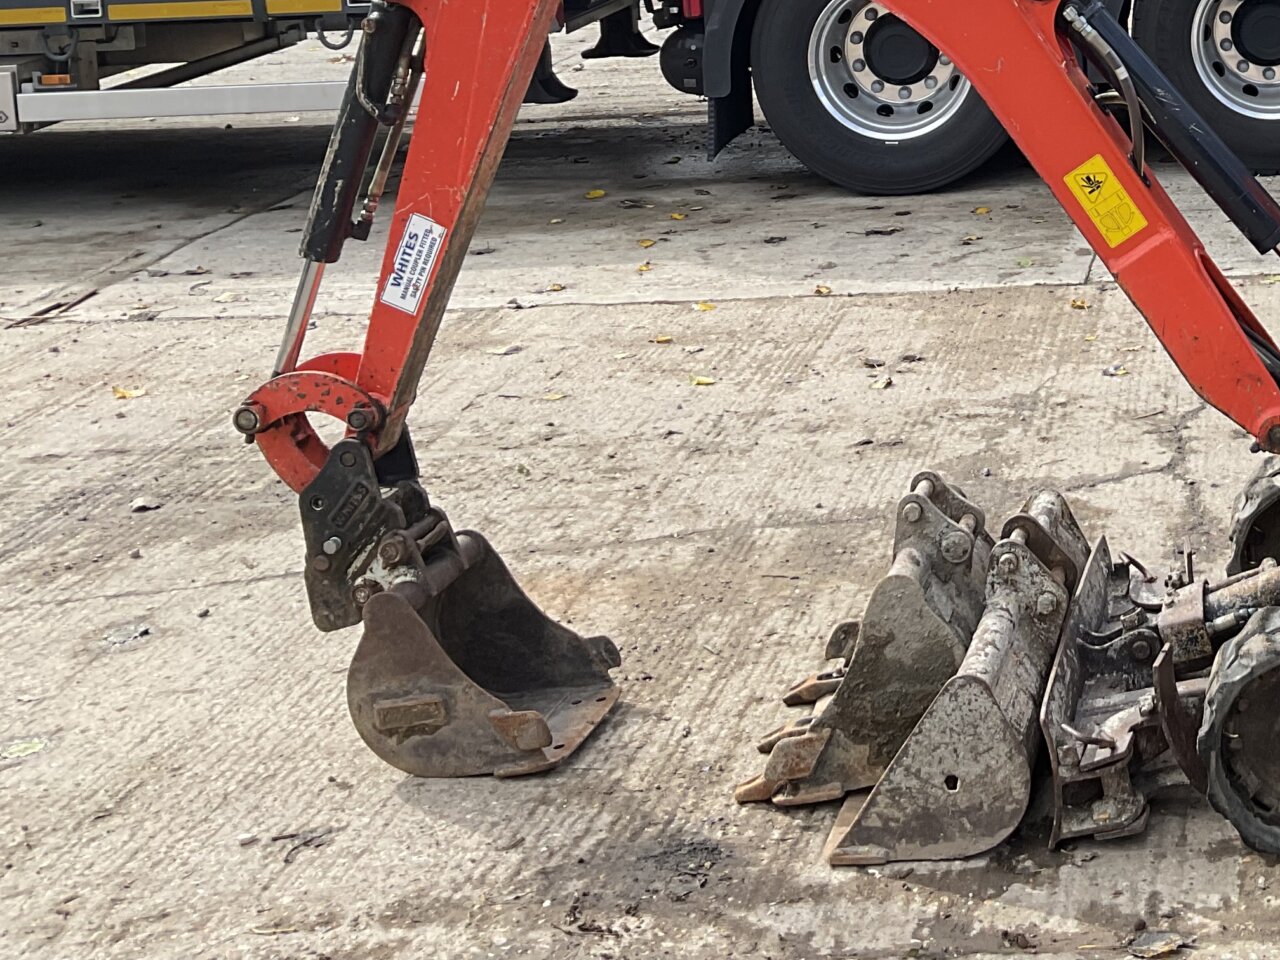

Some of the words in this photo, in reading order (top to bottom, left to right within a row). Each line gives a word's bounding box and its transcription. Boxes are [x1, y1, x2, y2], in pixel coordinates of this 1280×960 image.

[391, 231, 419, 287] WHITES
[400, 276, 412, 300] MANUAL
[409, 249, 422, 276] COUPLER
[419, 228, 431, 249] FITTED
[419, 266, 427, 277] PIN
[423, 237, 437, 266] REQUIRED
